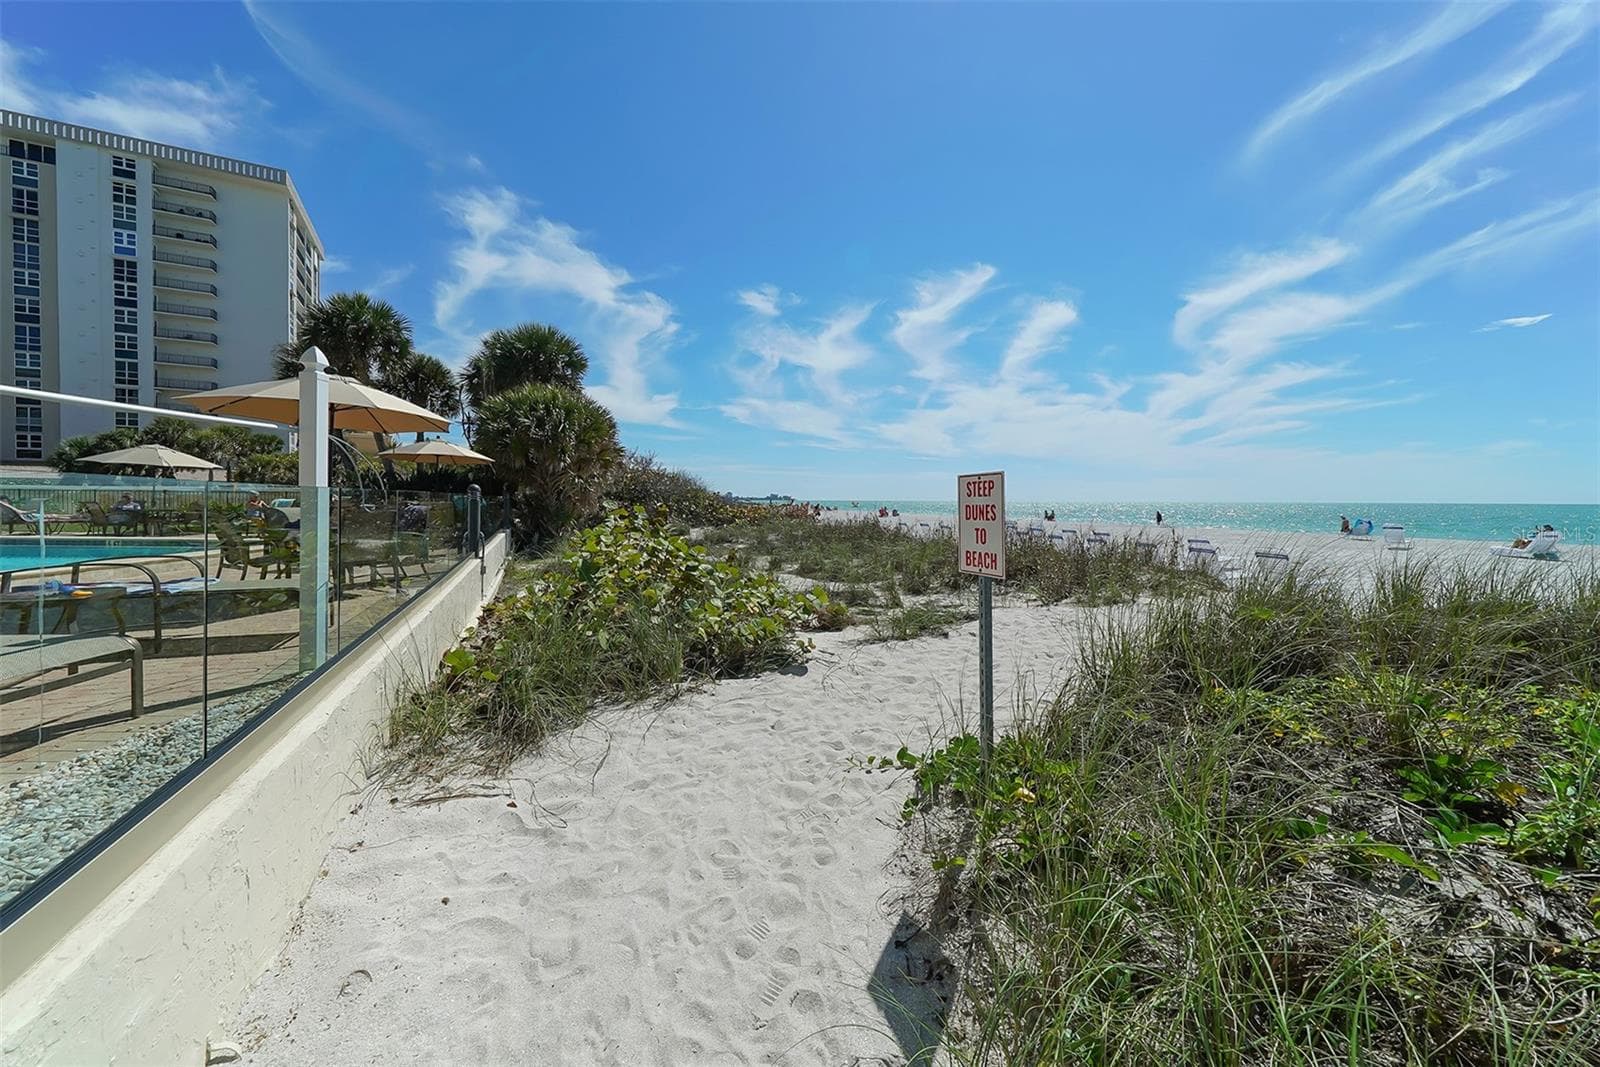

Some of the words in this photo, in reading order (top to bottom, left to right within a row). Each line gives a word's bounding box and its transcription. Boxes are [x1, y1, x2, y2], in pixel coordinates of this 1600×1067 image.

[966, 480, 995, 498] STEEP
[965, 504, 997, 522] DUNES
[974, 528, 987, 545] TO
[965, 550, 998, 570] BEACH
